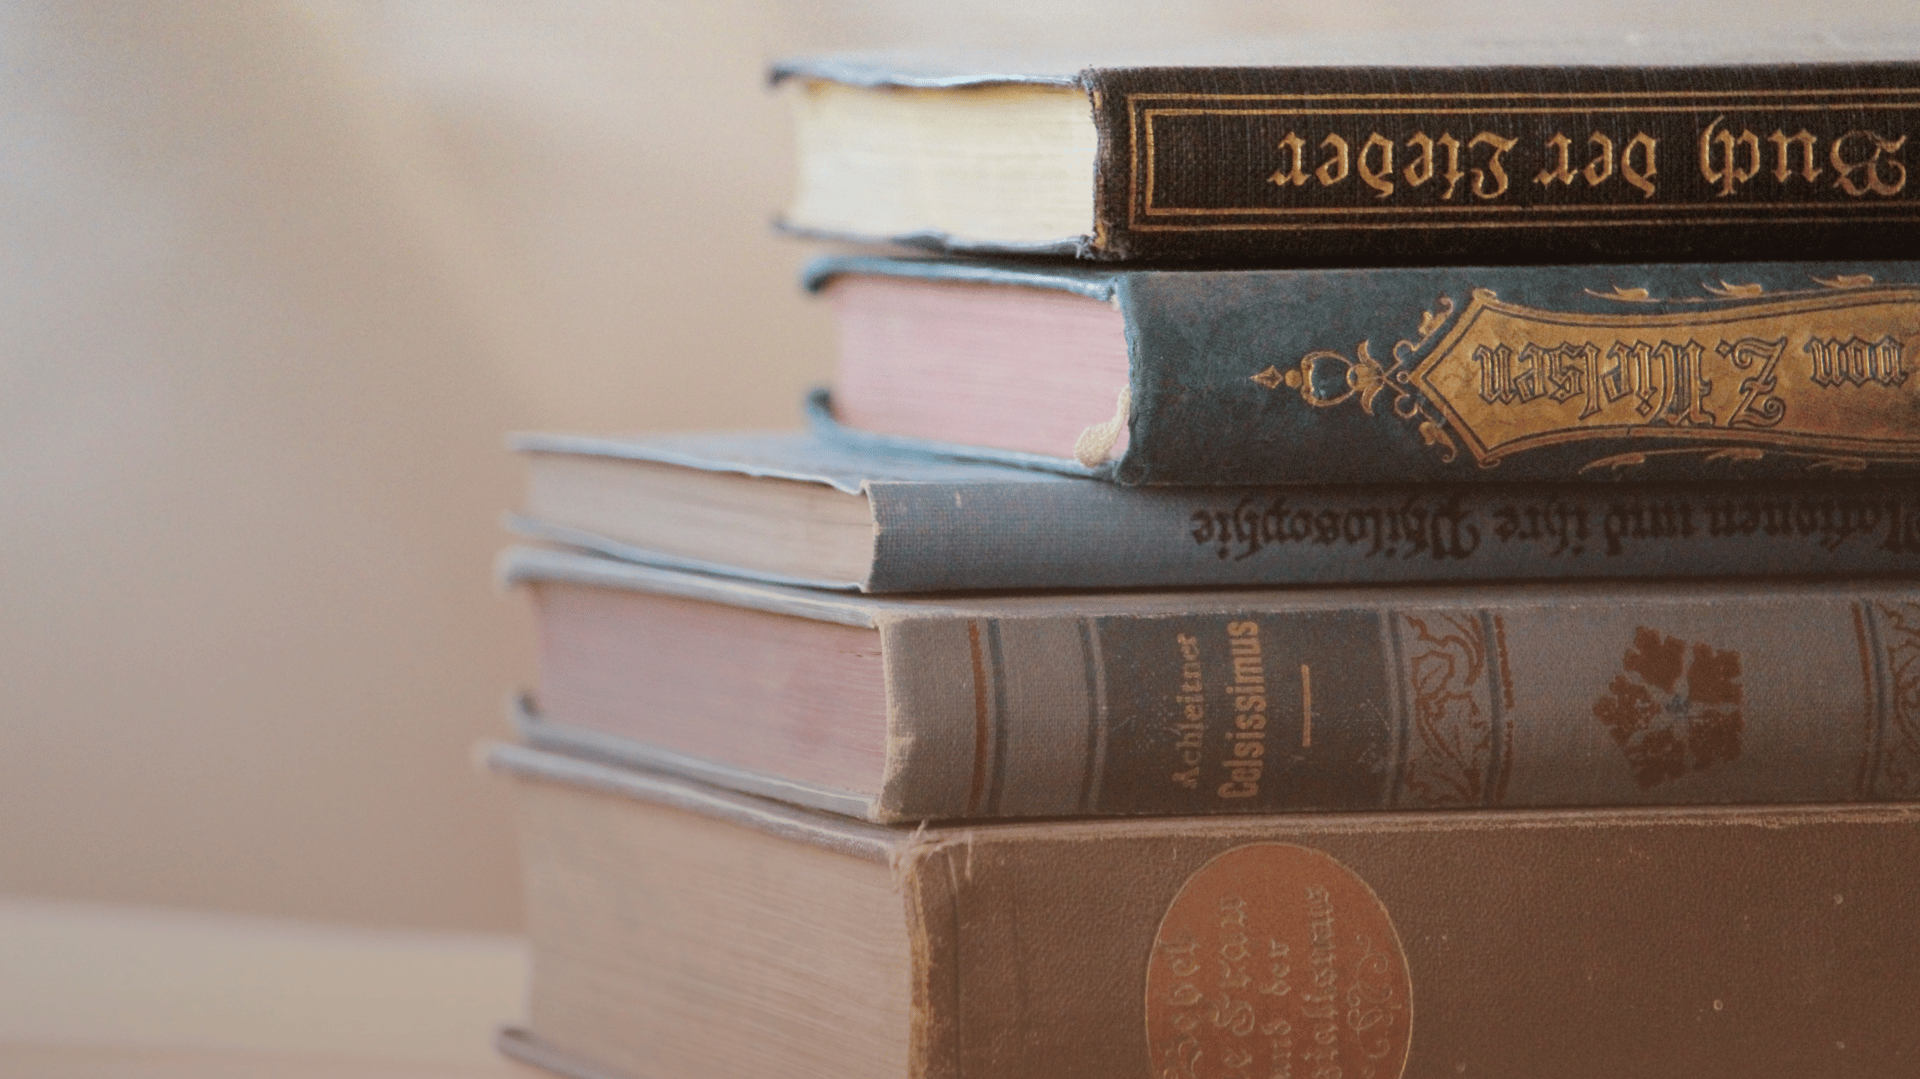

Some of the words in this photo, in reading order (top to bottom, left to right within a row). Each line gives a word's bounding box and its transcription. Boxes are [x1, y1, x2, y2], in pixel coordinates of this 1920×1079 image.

[1267, 129, 1518, 199] Lieder
[1534, 129, 1660, 199] der
[1701, 114, 1906, 196] Buch
[1473, 336, 1716, 428] Nielsen
[1806, 334, 1907, 388] von
[1190, 492, 1482, 561] Philosophie
[1493, 494, 1590, 558] ihre
[1604, 500, 1697, 557] und
[1171, 632, 1205, 789] Achleitner
[1217, 620, 1267, 798] Celsissimus
[1258, 937, 1293, 998] der
